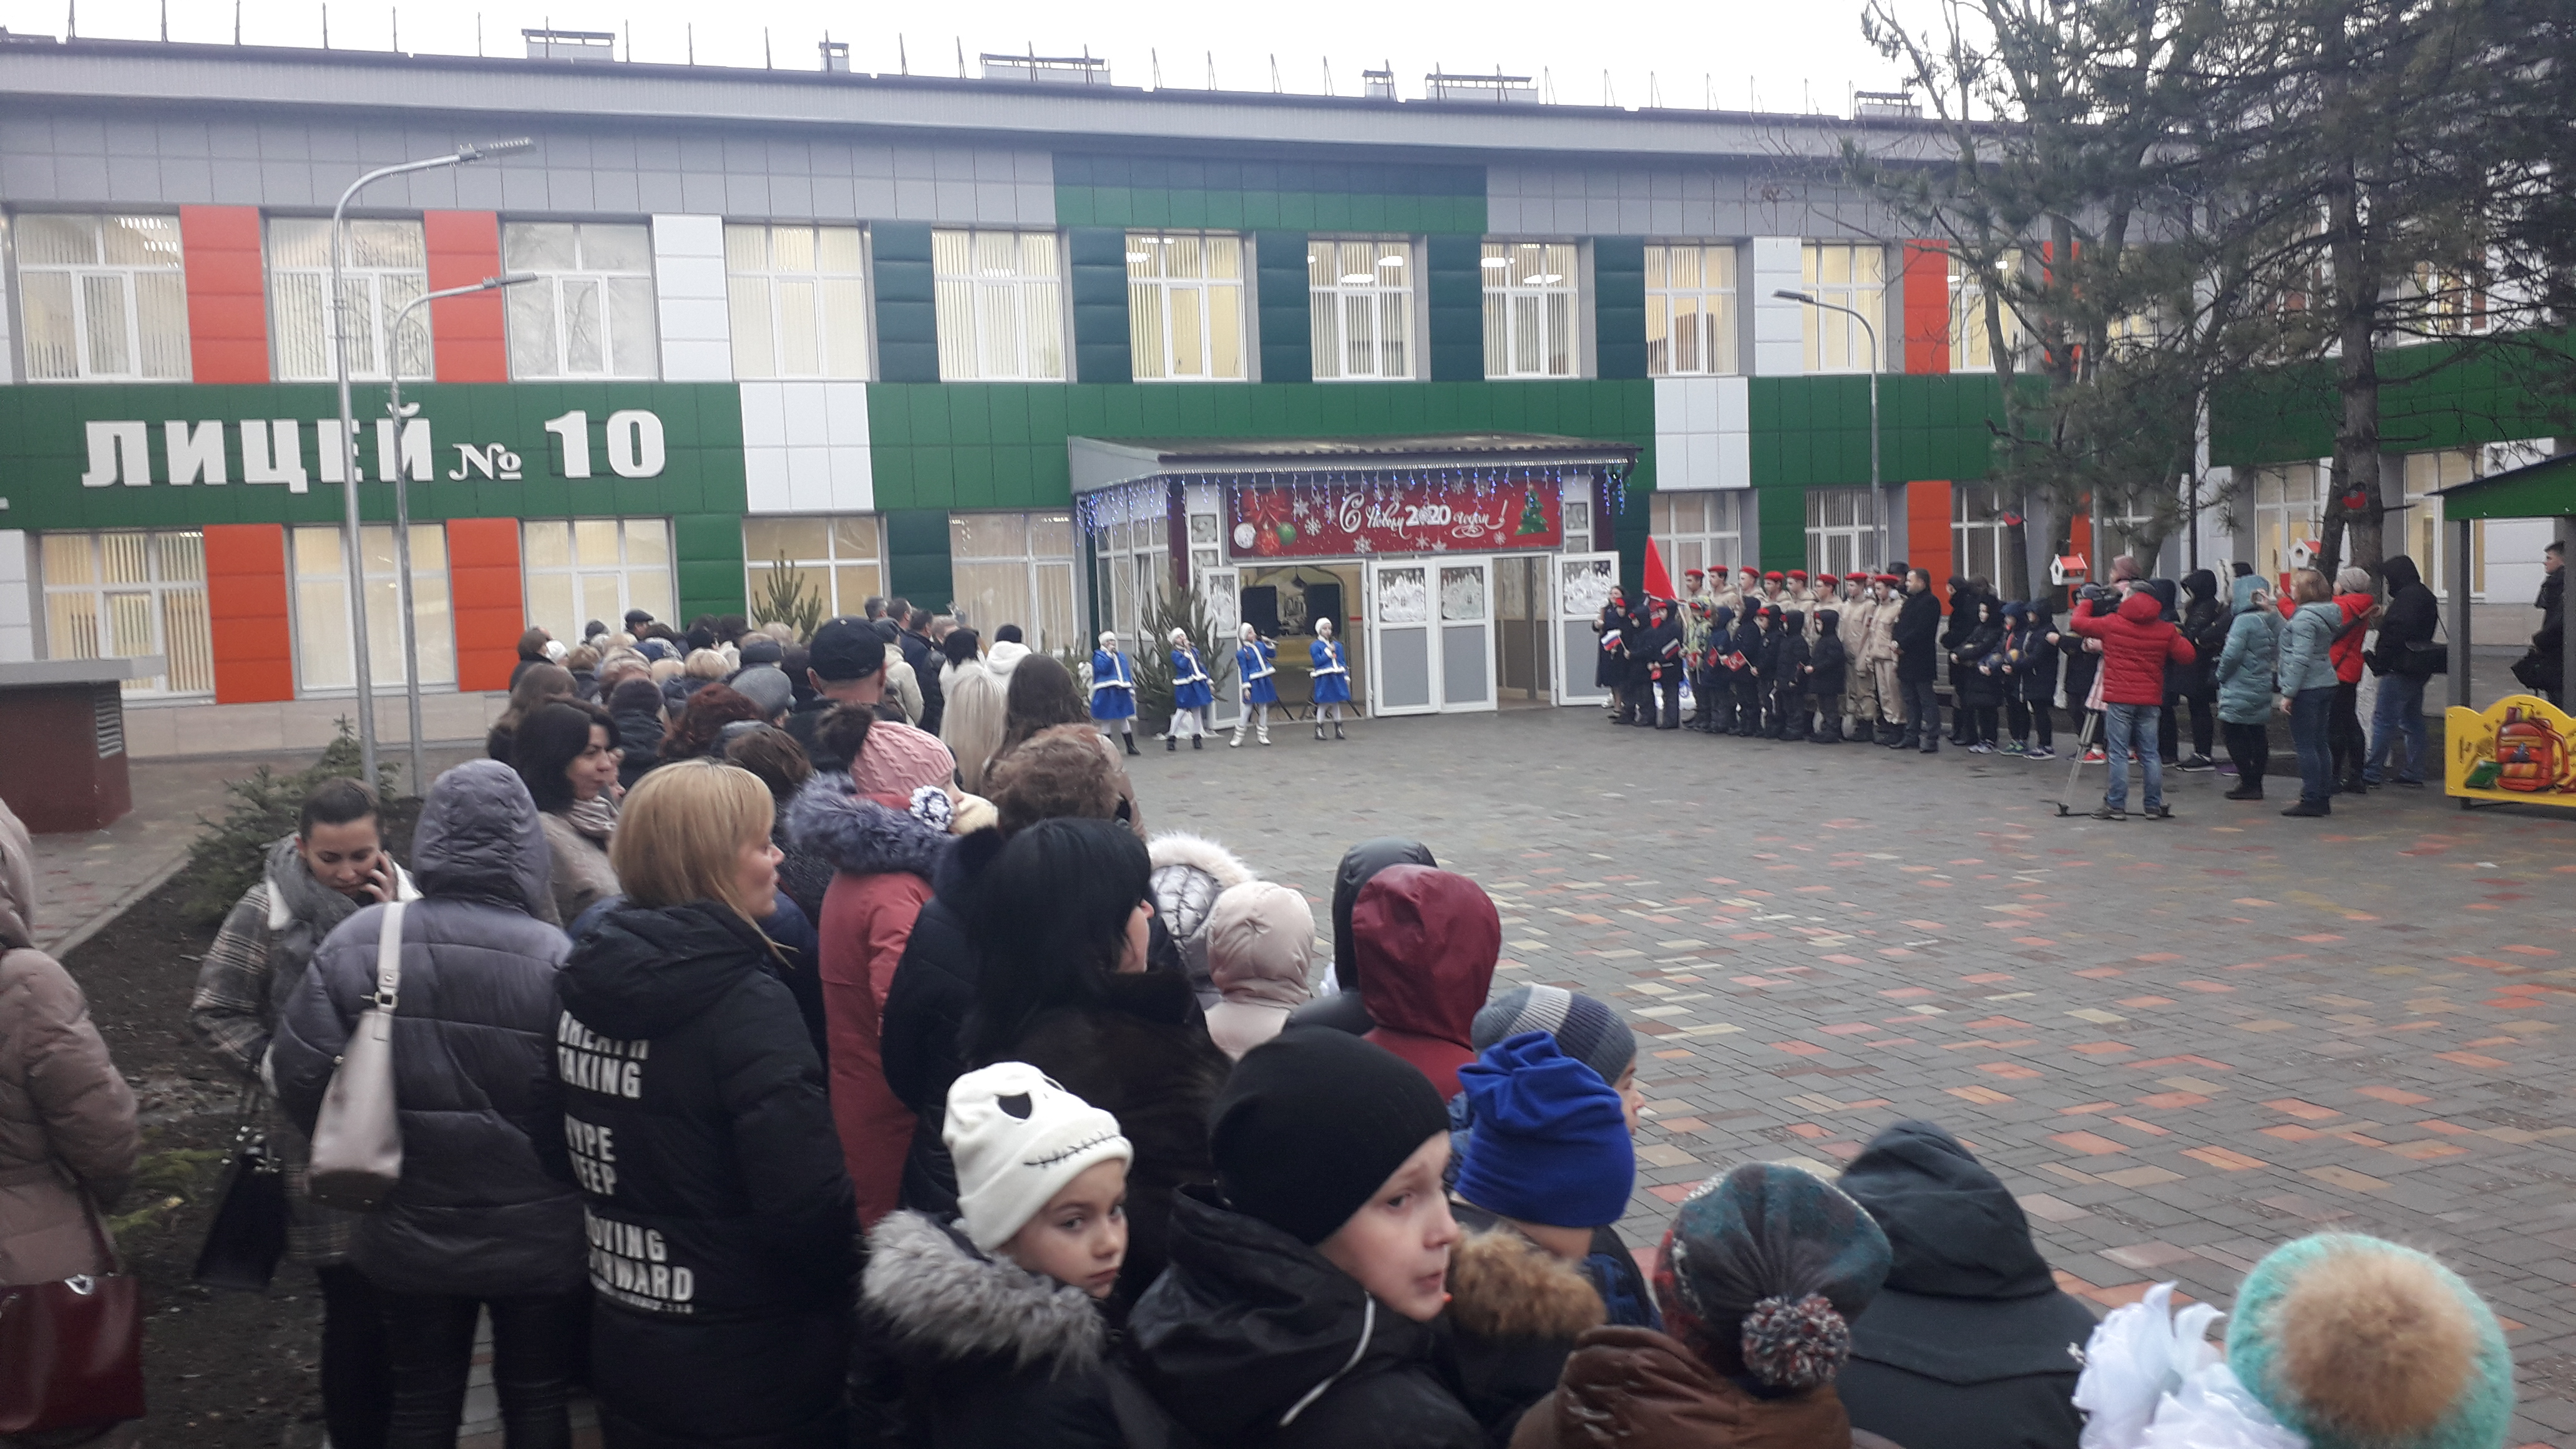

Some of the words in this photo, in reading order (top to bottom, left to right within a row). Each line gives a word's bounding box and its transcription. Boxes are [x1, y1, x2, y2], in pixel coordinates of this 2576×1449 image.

[82, 401, 434, 494] ЛИЦЕЙ
[448, 442, 523, 481] №
[545, 409, 666, 479] 10
[1339, 491, 1365, 533] С
[1405, 504, 1451, 527] 2020
[567, 1149, 618, 1196] EEP
